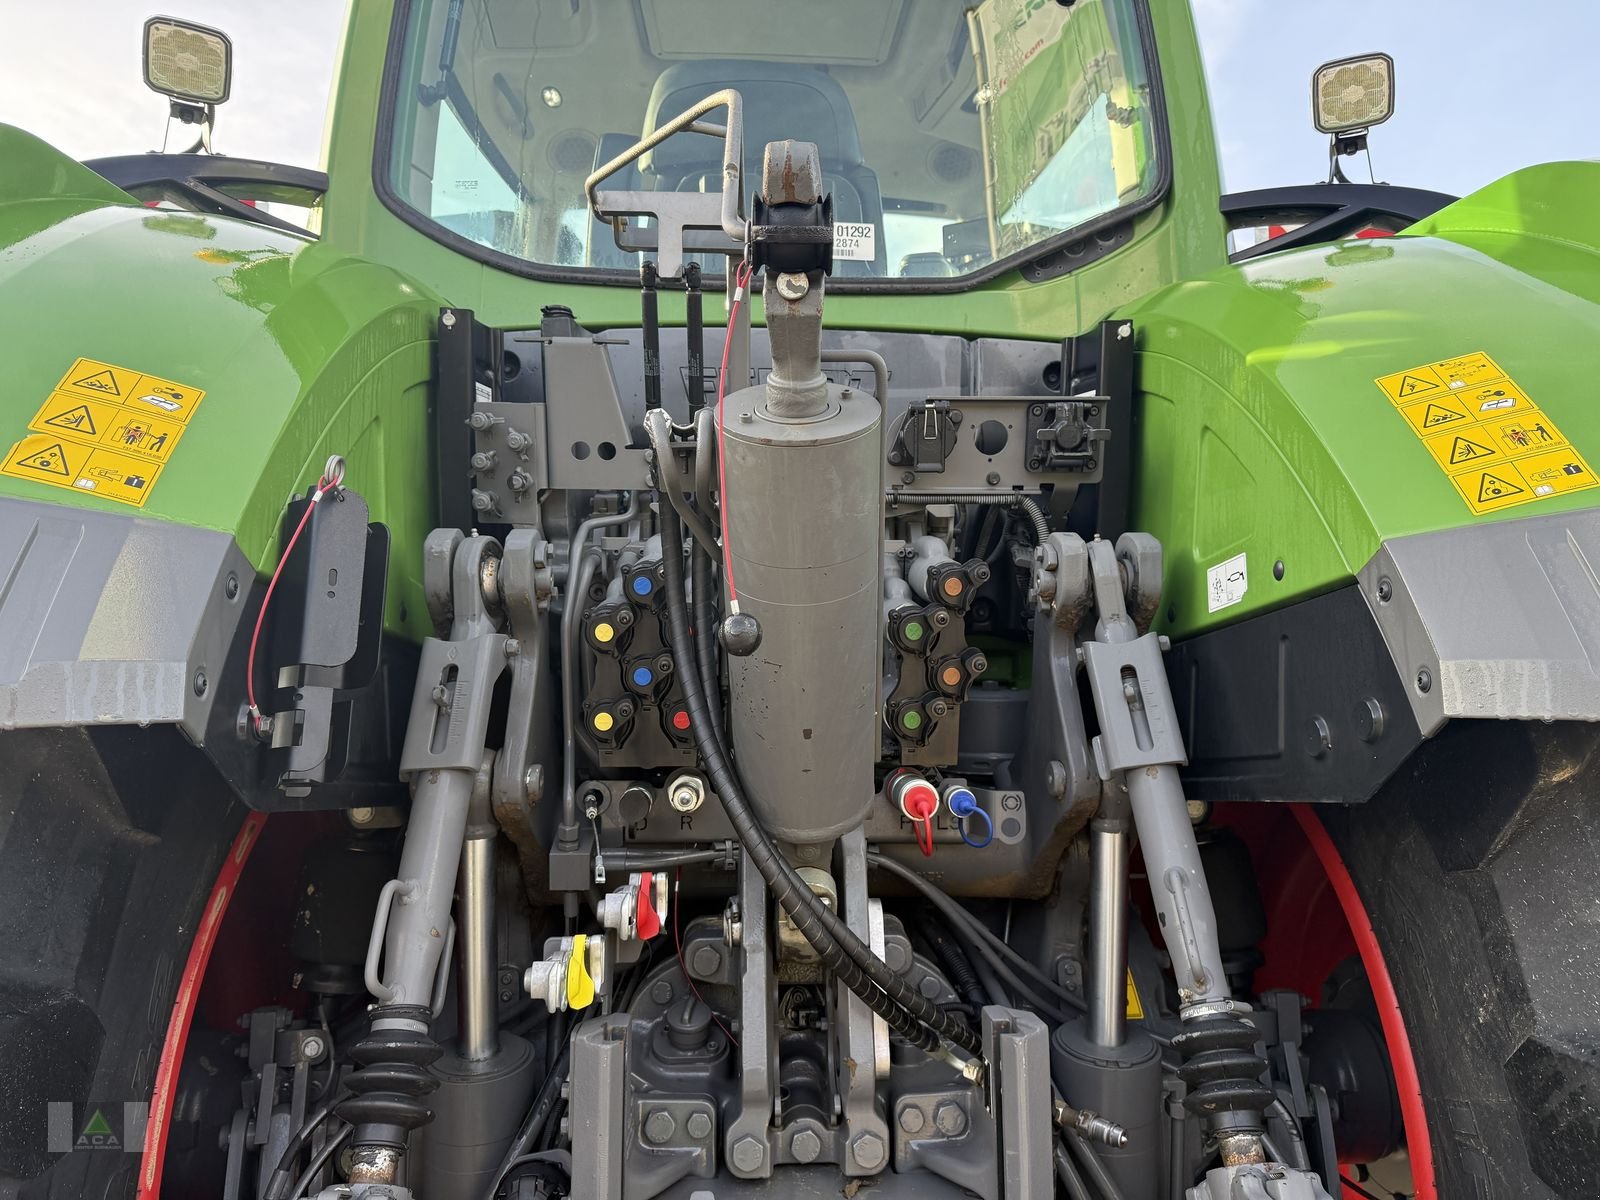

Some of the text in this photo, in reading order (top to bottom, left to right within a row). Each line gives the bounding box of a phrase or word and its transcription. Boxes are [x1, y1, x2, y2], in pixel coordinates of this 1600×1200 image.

[836, 225, 871, 239] 01292
[835, 238, 860, 248] 2874
[680, 815, 693, 830] R
